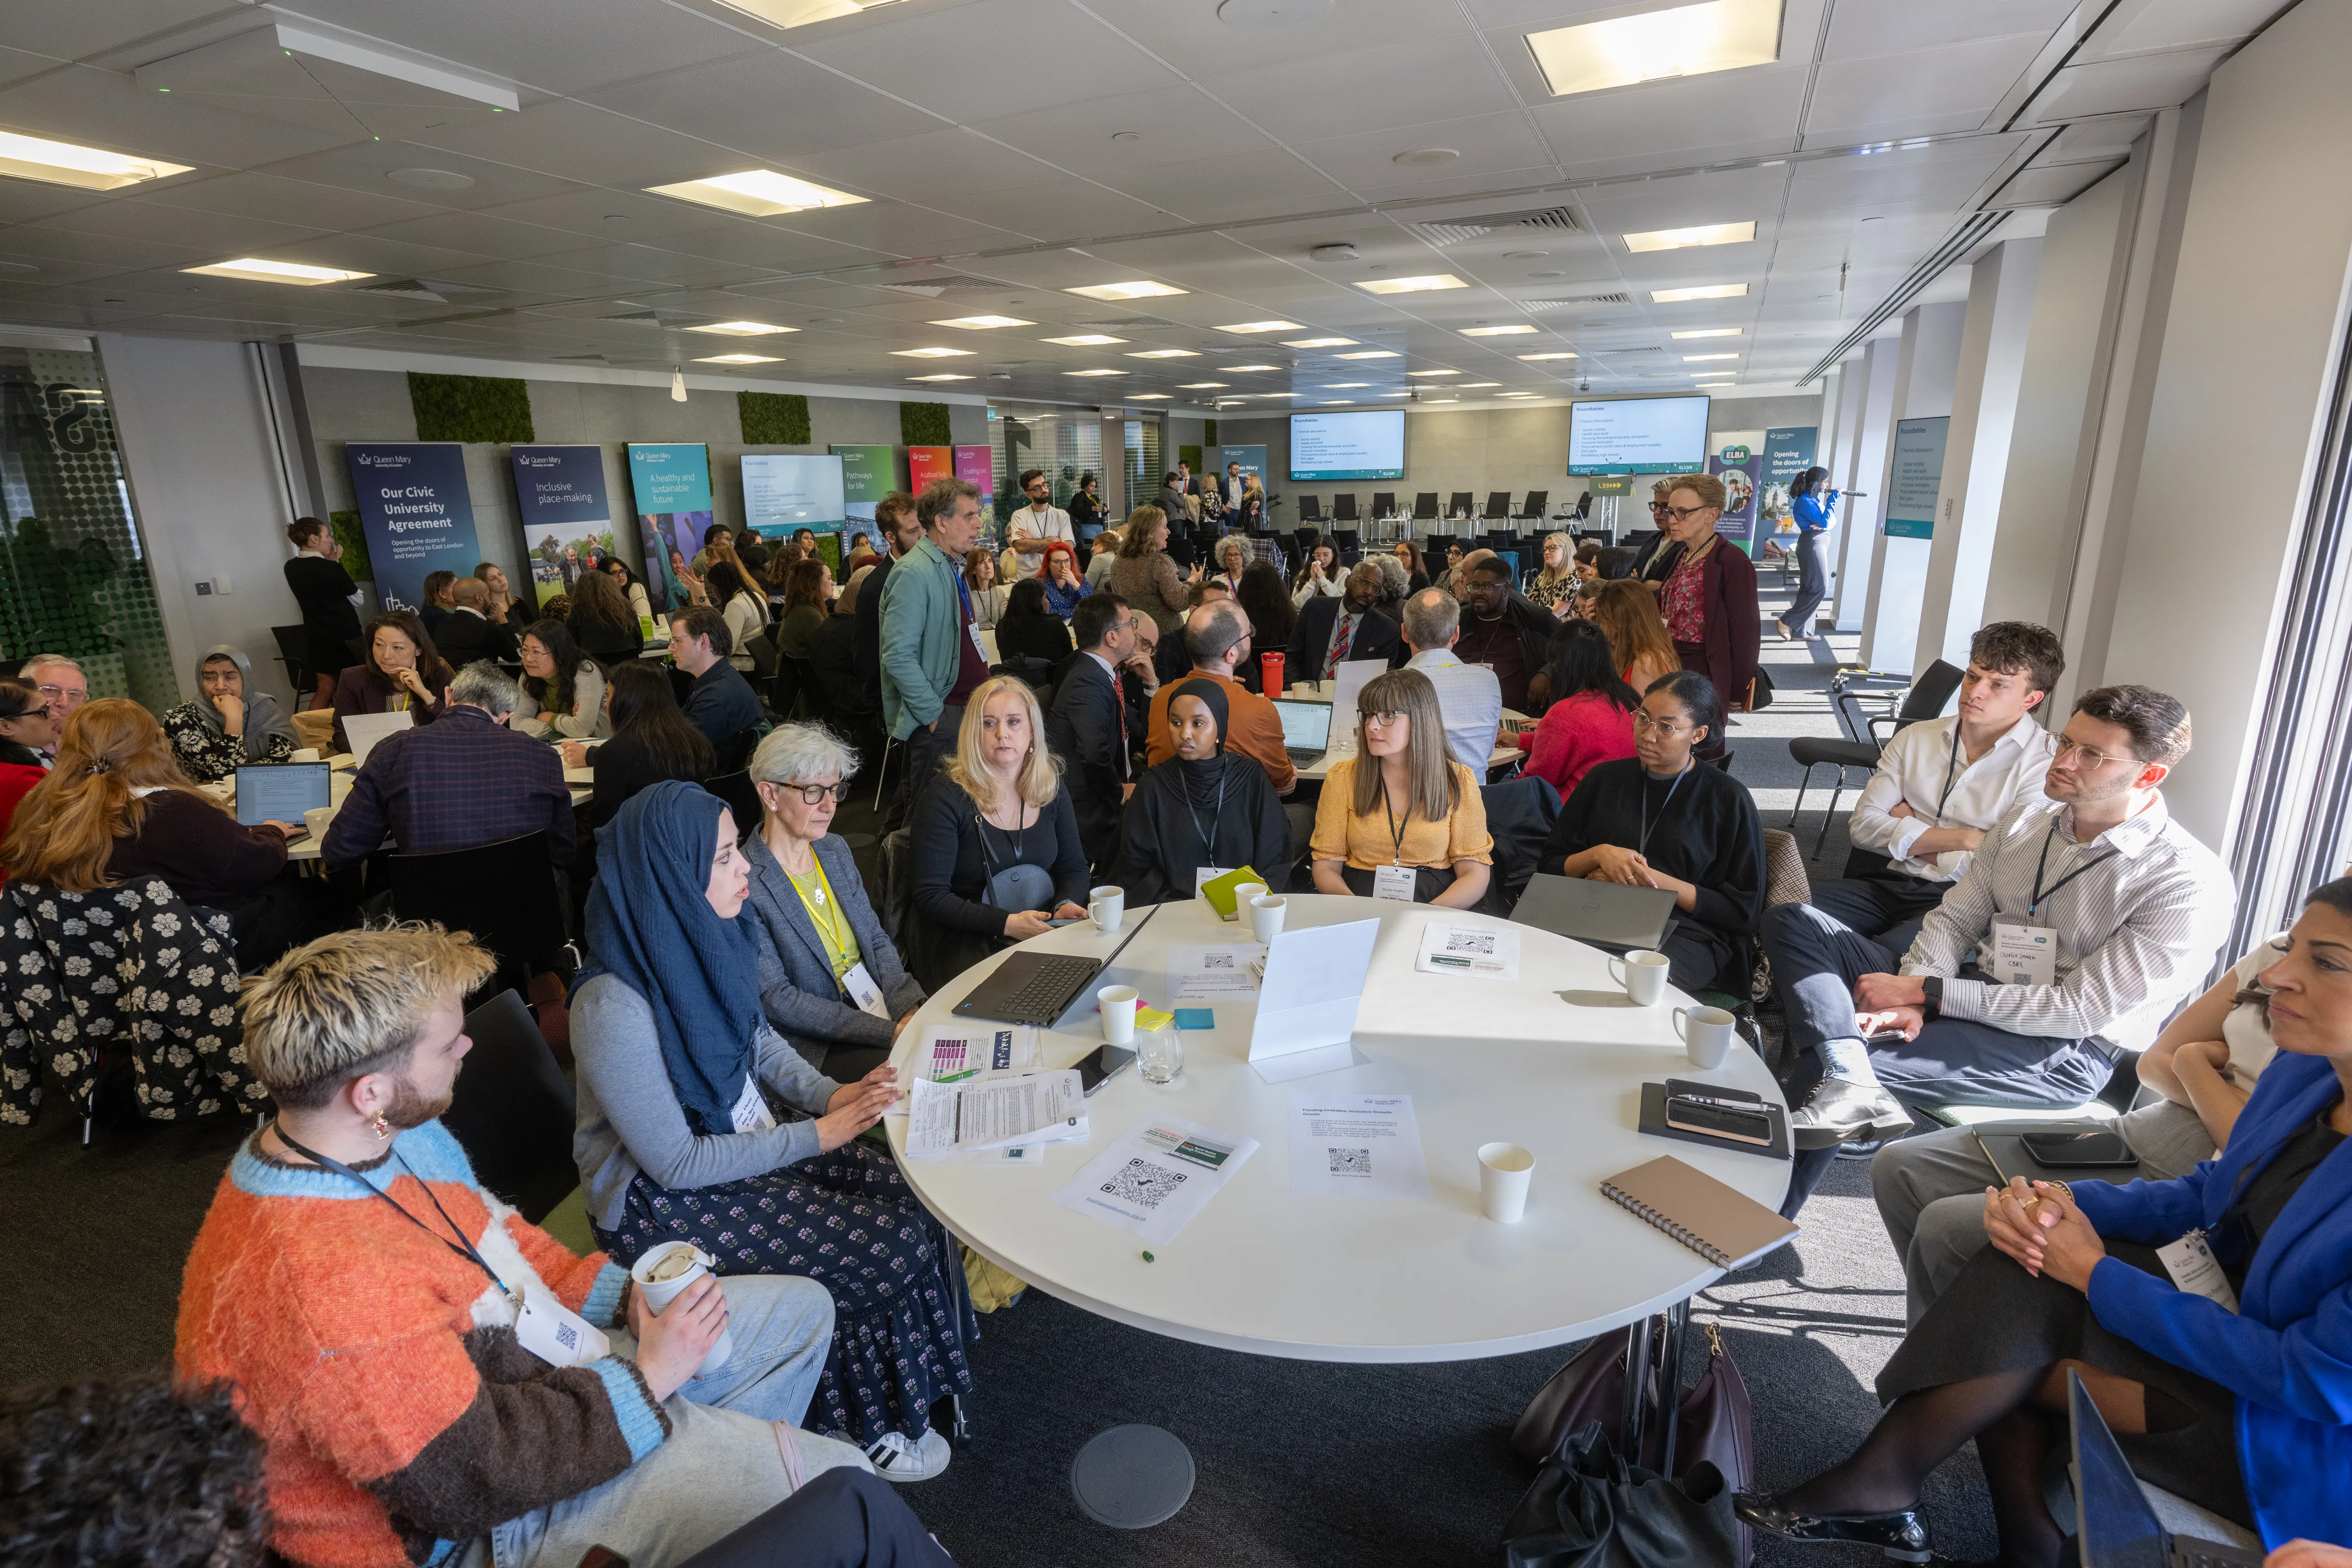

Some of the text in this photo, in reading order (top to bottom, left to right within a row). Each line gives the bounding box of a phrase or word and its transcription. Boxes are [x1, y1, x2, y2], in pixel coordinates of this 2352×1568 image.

[395, 456, 411, 464] Mary
[656, 474, 680, 483] healthy
[682, 472, 695, 481] and
[536, 482, 572, 491] Inclusive
[652, 484, 689, 493] sustainable
[382, 486, 435, 498] Our Civic
[539, 493, 593, 505] place-making
[654, 495, 673, 503] future
[385, 502, 444, 514] University
[389, 517, 452, 533] Agreement
[1194, 1149, 1216, 1158] Procurement:
